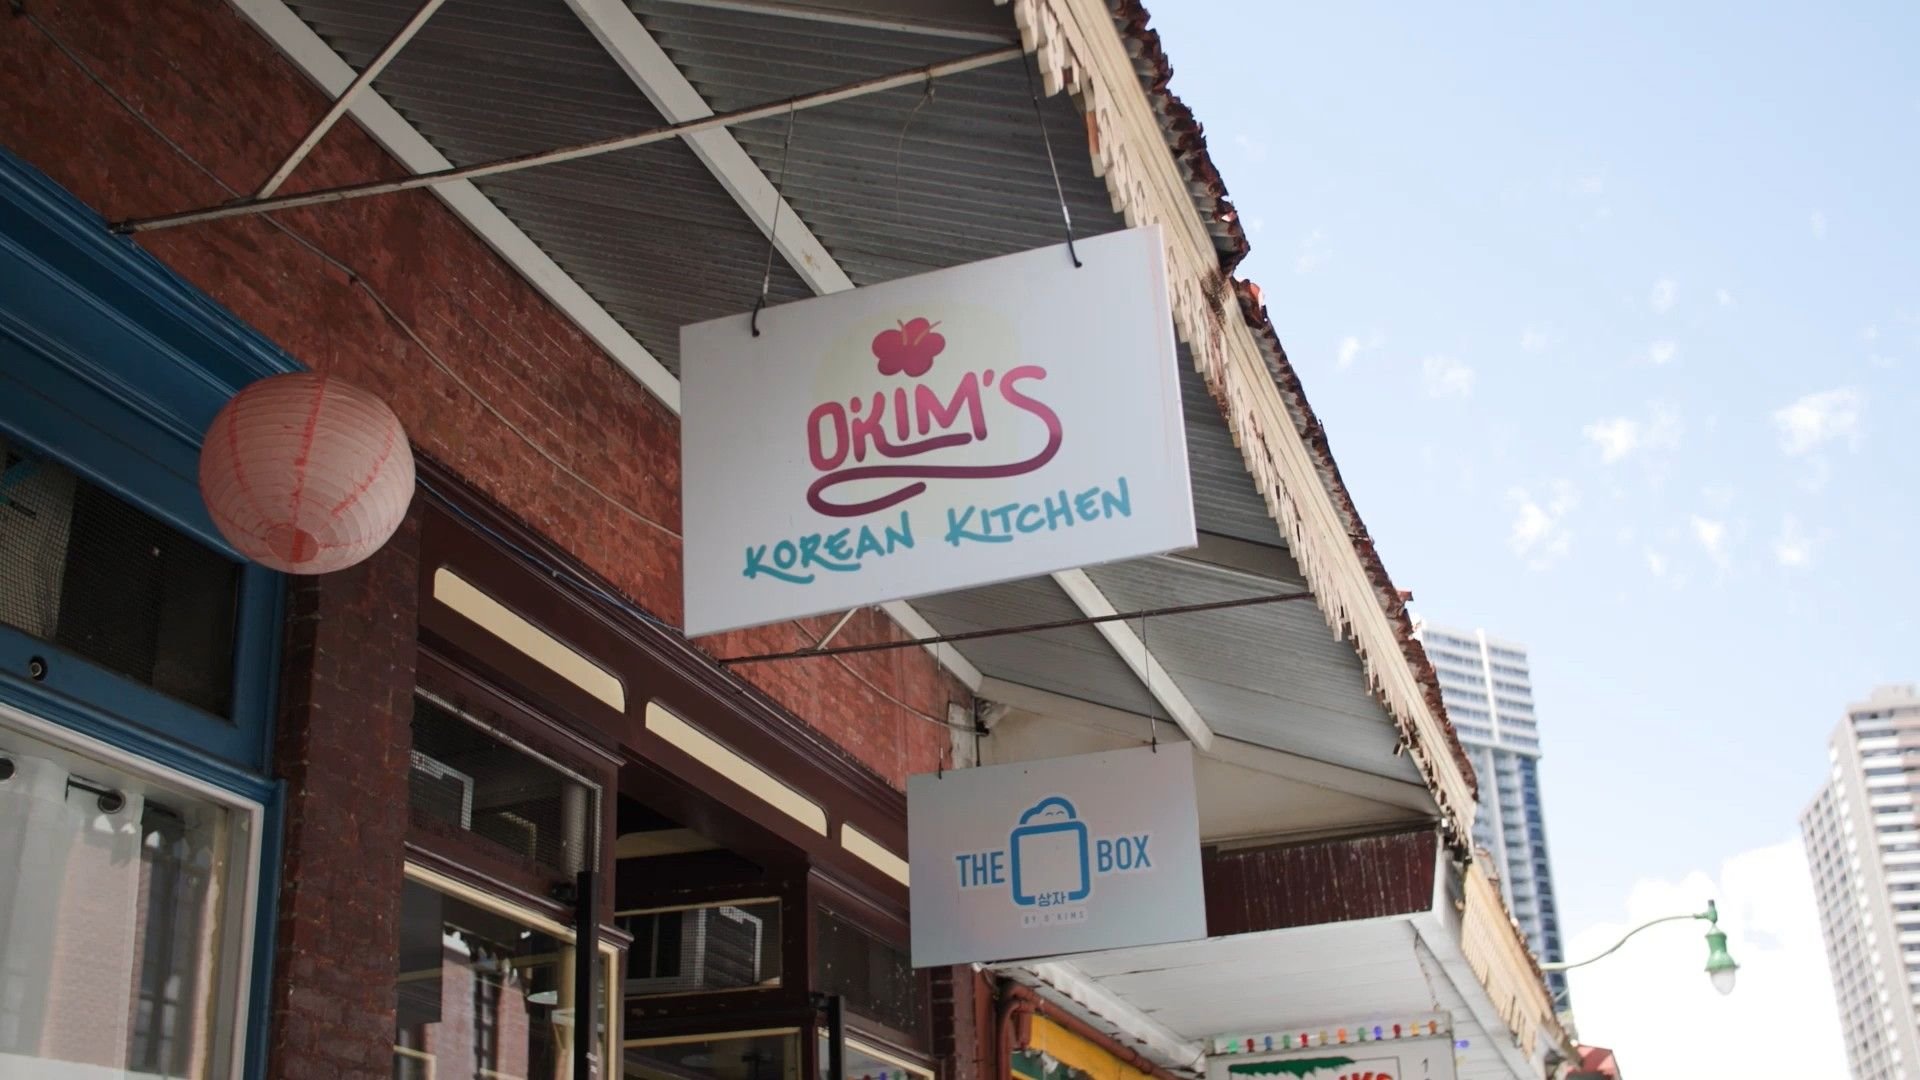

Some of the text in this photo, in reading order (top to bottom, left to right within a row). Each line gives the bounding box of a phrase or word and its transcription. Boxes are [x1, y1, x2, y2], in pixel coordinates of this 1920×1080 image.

[742, 477, 1133, 585] KOREAN KITCHEN
[956, 835, 1152, 888] THE BOX
[1038, 891, 1067, 907] 상자
